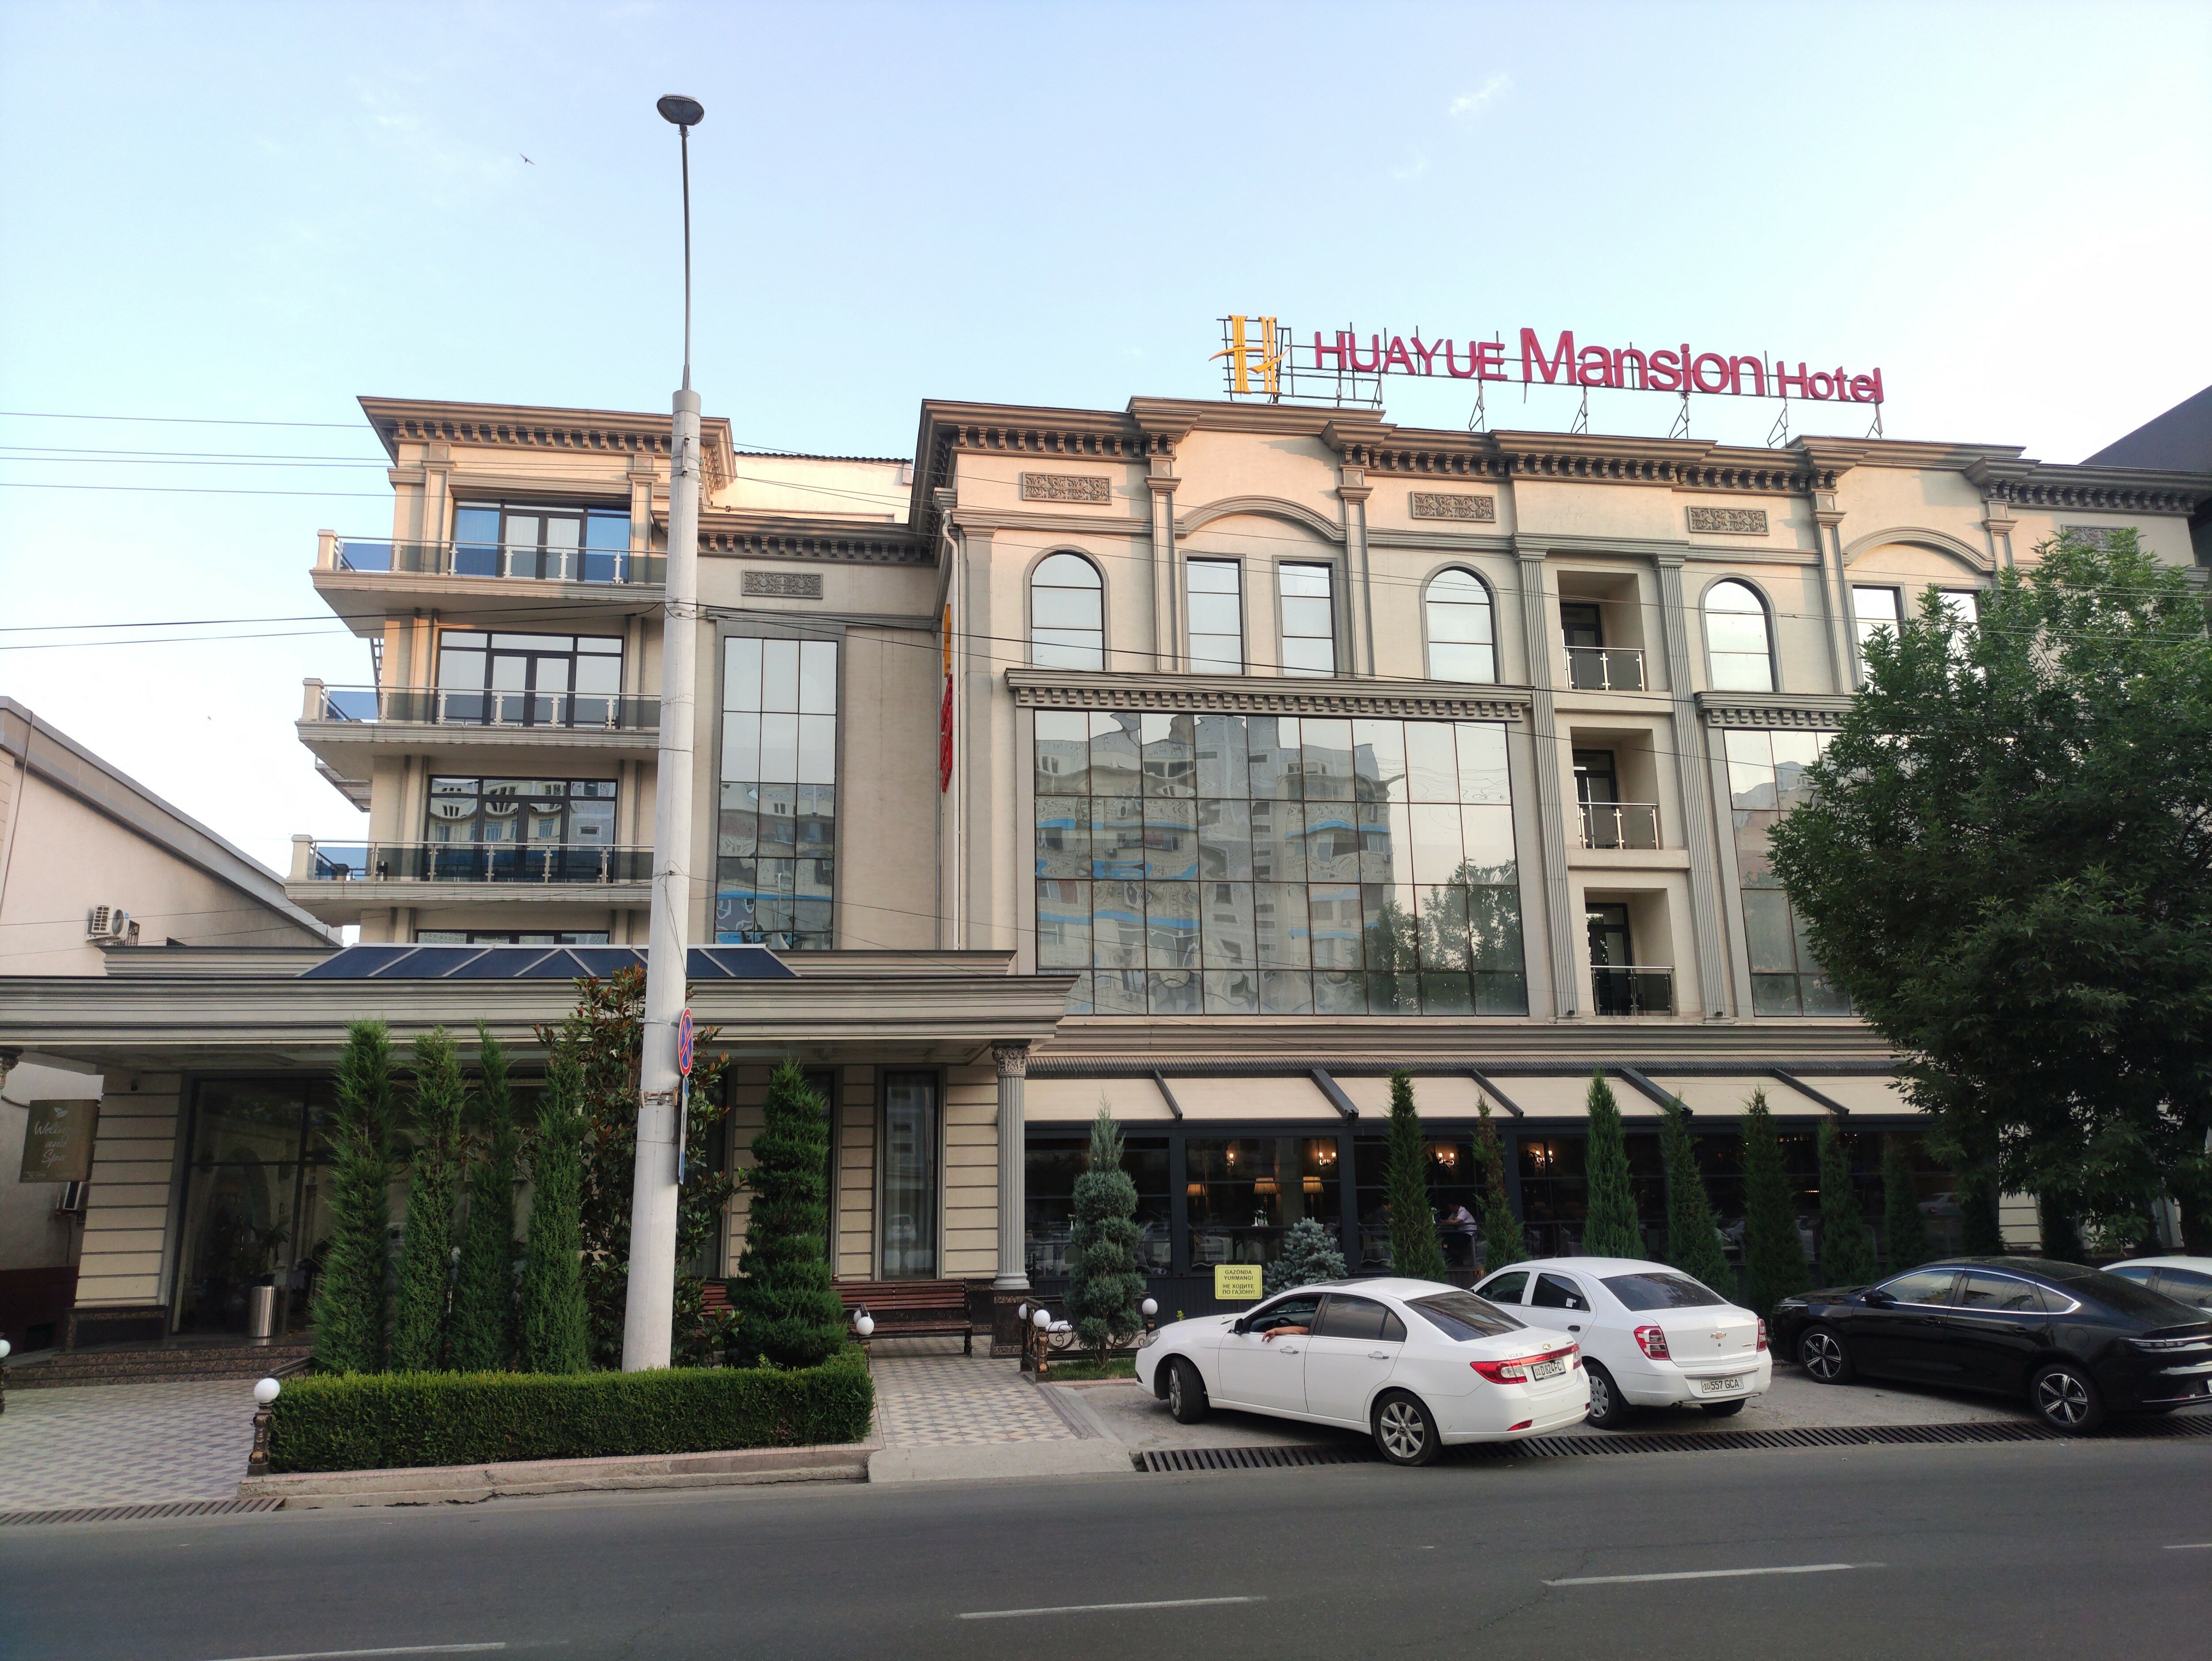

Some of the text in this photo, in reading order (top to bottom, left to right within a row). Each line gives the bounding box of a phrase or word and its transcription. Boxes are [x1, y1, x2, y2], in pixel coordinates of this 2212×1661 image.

[1314, 328, 1884, 404] HUAYUE Mansion Hotel
